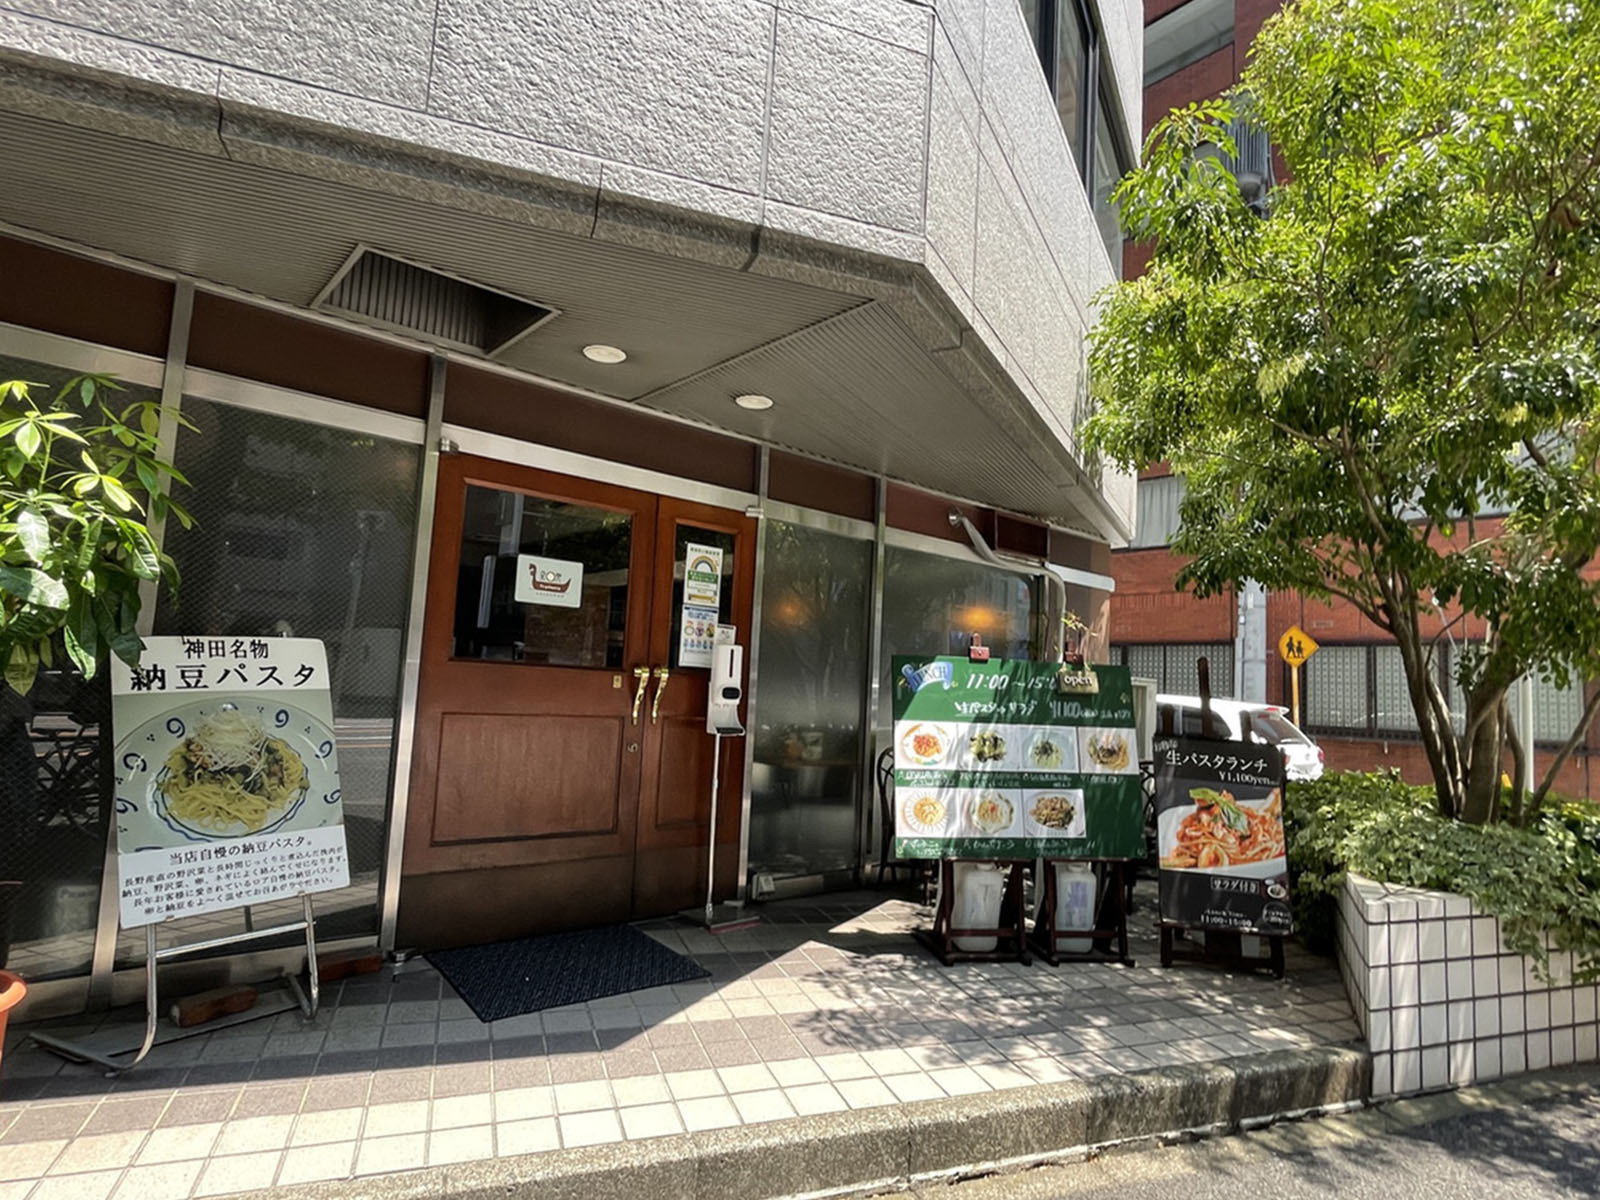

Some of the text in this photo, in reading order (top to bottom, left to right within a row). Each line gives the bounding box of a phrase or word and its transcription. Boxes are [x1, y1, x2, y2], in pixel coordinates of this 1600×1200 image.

[185, 639, 269, 659] 神田名物
[131, 663, 315, 691] 納豆パスタ
[1064, 674, 1093, 687] open
[1166, 749, 1268, 773] 生パスタランチ
[170, 836, 313, 865] 当店自慢の納豆パスタ。
